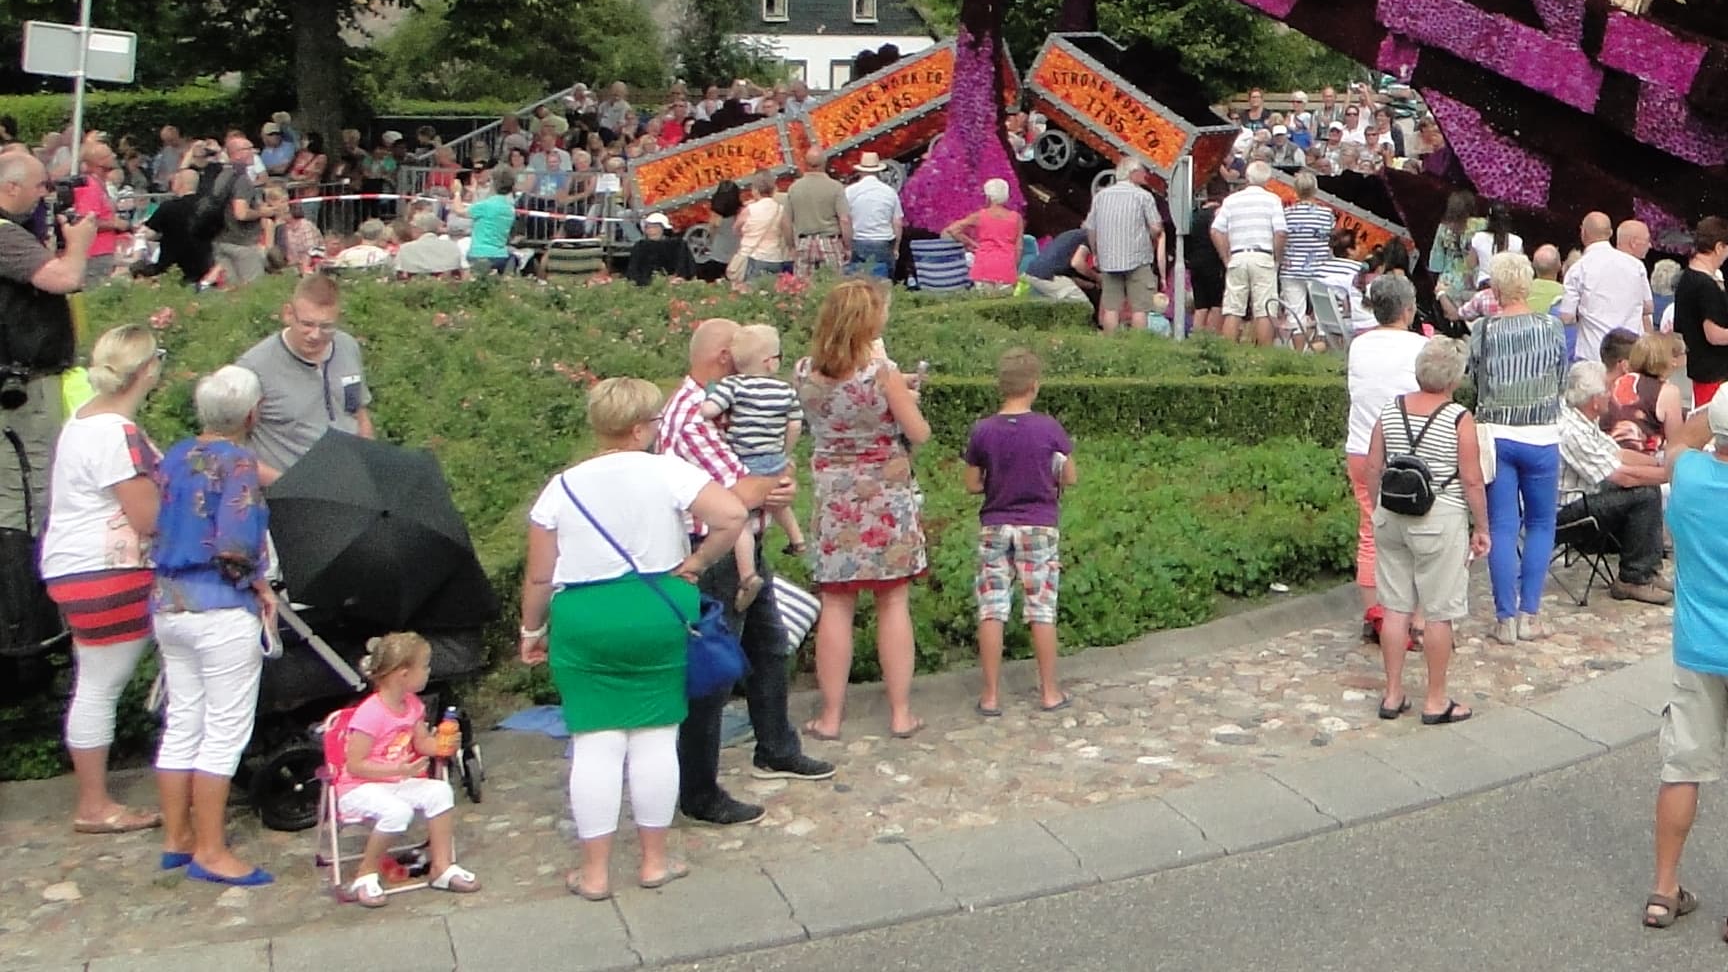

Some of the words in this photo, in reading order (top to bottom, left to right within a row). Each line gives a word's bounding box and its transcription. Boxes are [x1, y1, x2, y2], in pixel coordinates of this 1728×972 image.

[834, 91, 876, 137] STRONG
[879, 72, 919, 93] WORK
[872, 92, 914, 122] 1785
[1052, 71, 1107, 92] STRONG
[1113, 87, 1148, 125] WORK
[1086, 96, 1125, 133] 1785
[655, 153, 700, 196] STRONG
[705, 144, 745, 159] WORK
[695, 163, 734, 186] 1785
